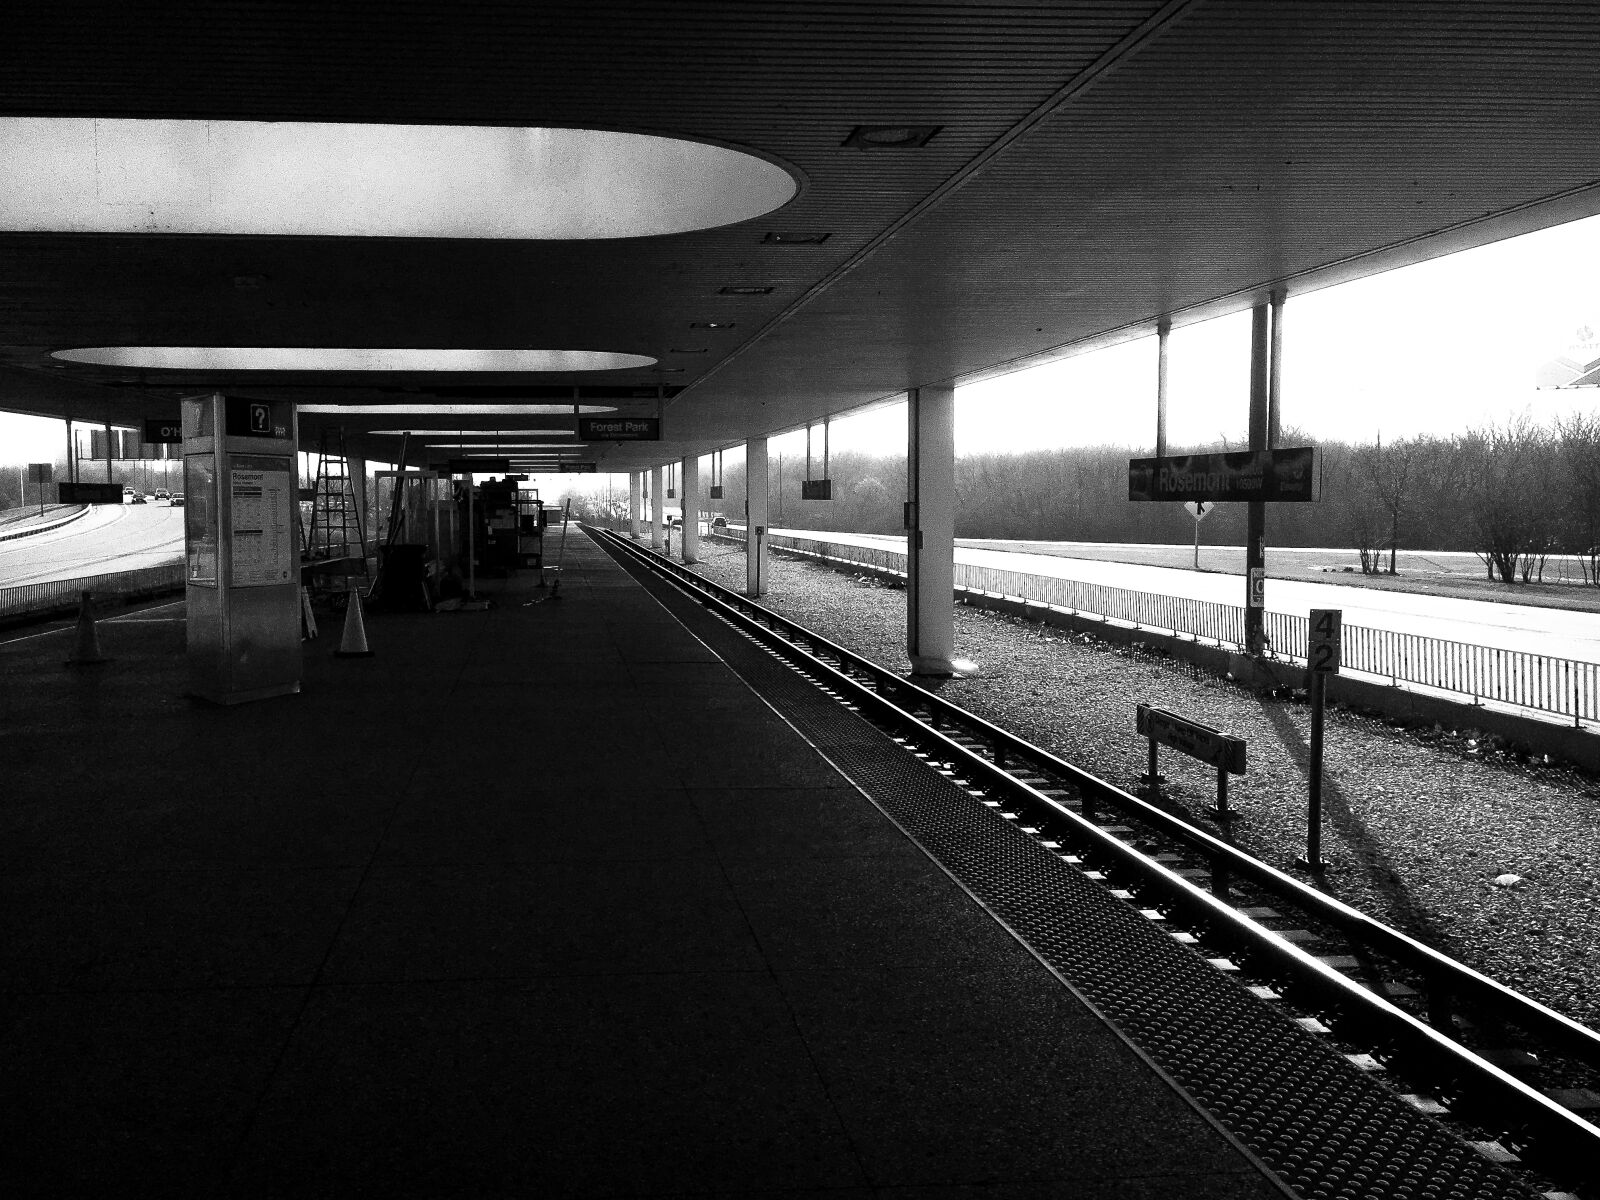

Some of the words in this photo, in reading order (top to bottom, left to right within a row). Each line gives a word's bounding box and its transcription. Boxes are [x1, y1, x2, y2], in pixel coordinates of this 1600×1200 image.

[160, 426, 182, 437] O'H
[590, 422, 623, 432] Forest
[625, 422, 649, 432] Park
[232, 472, 264, 481] Rosemont
[1159, 468, 1230, 492] Rosemont
[1315, 612, 1335, 638] 4
[1314, 644, 1333, 672] 2
